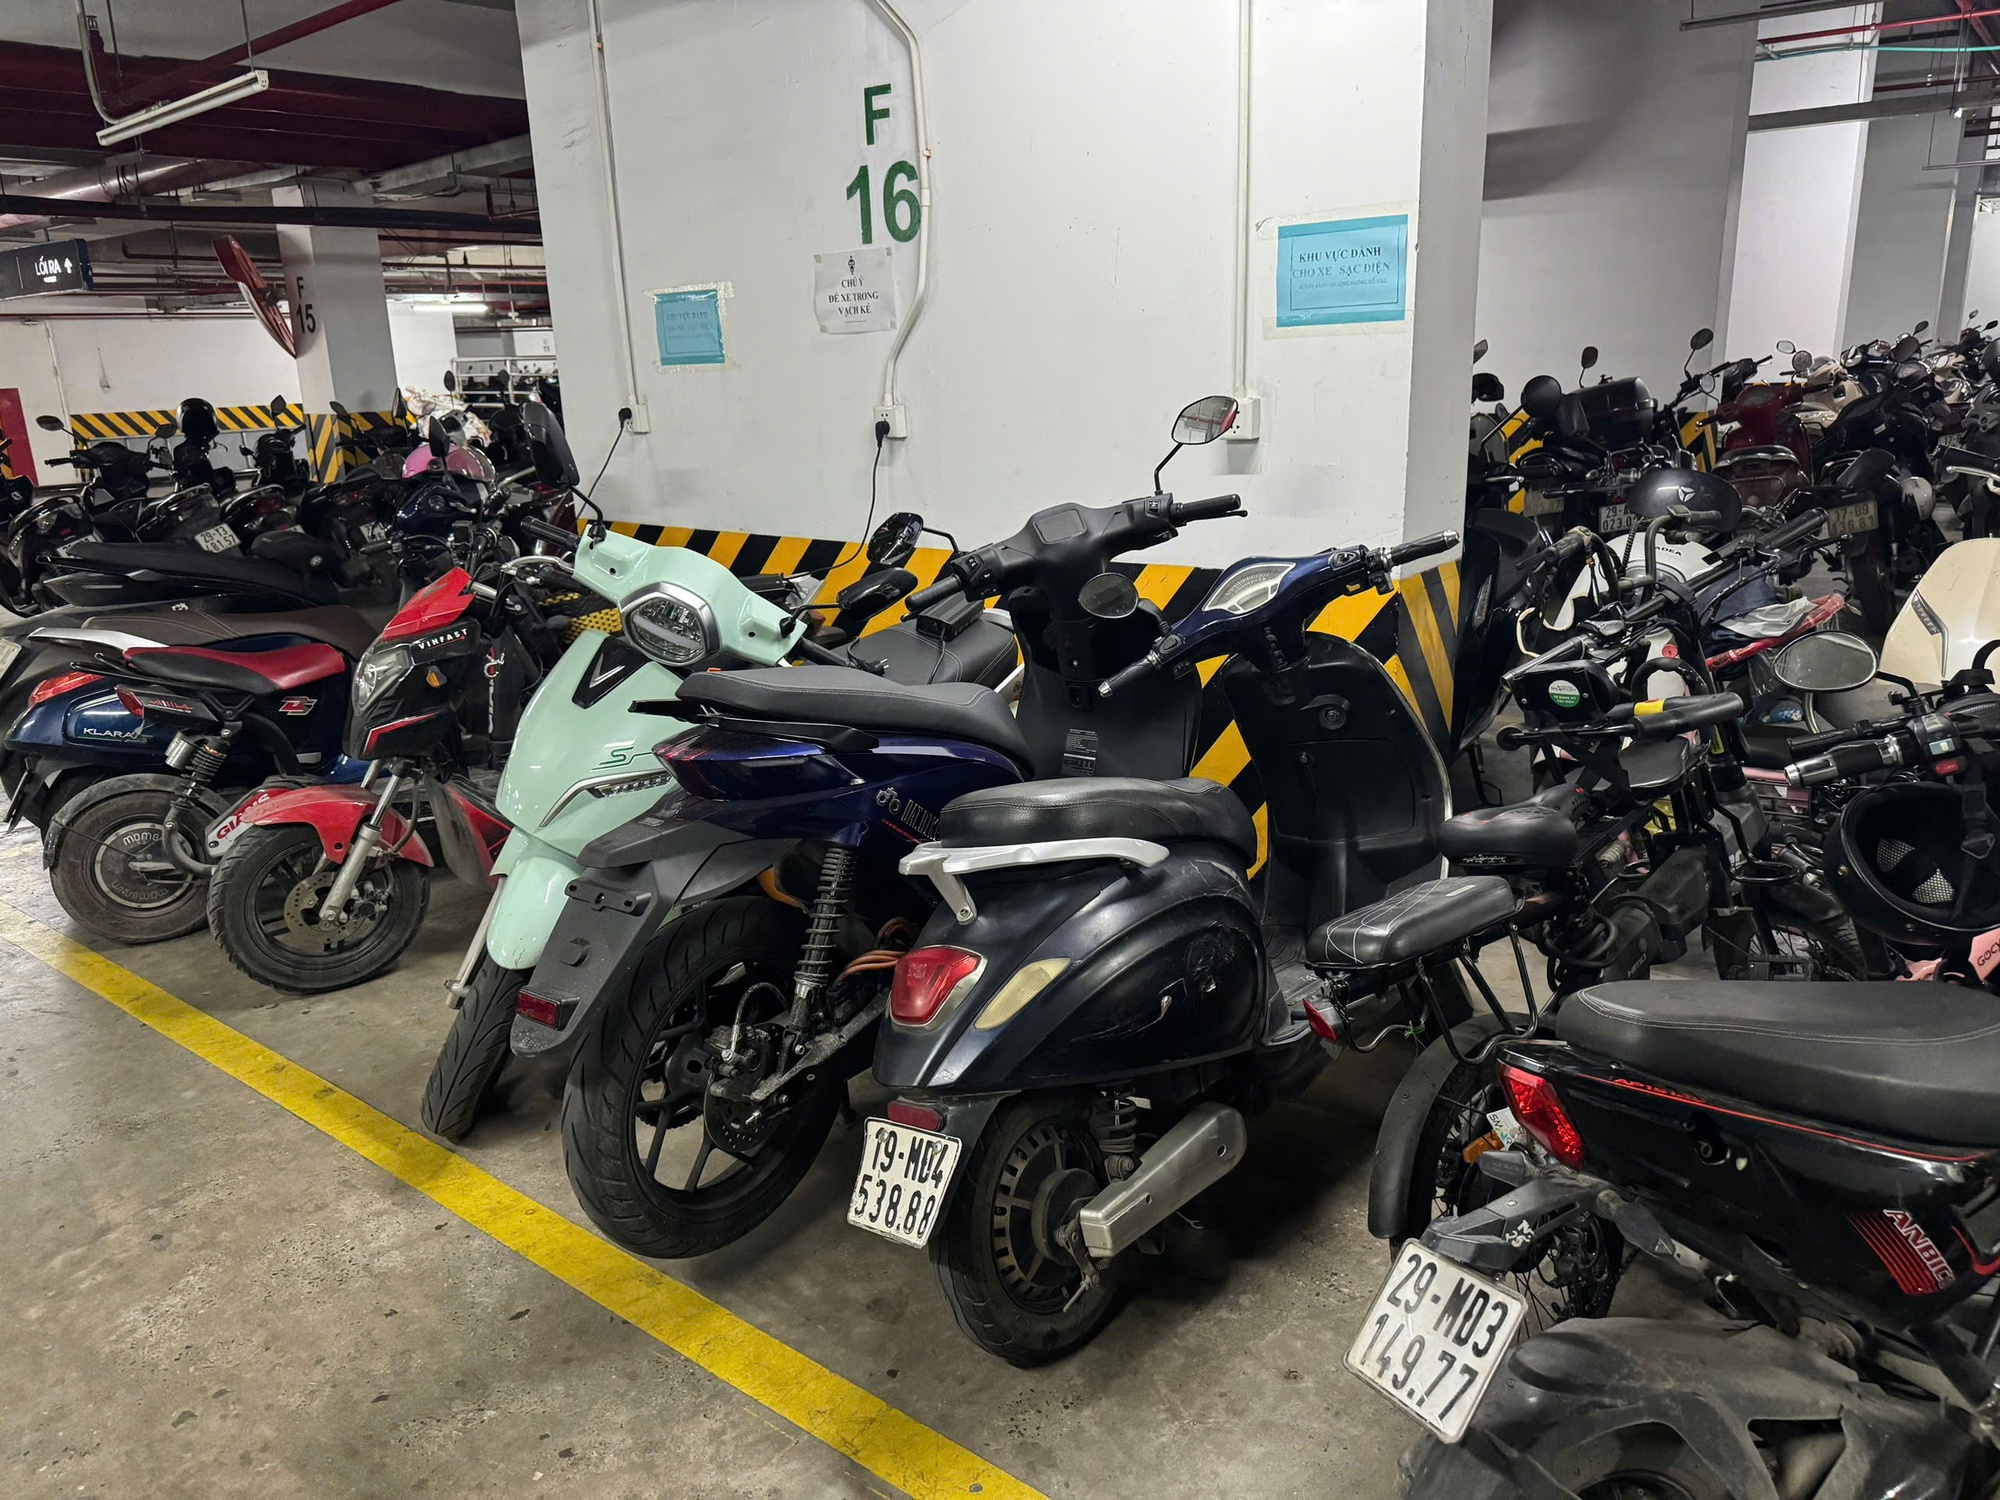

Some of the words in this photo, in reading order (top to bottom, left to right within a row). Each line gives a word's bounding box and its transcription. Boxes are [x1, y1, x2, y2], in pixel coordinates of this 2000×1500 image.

[864, 83, 891, 146] F
[846, 160, 922, 245] 16
[1299, 251, 1322, 263] KHU
[1325, 248, 1349, 262] VỰC
[1351, 246, 1381, 259] DÀNH
[1292, 267, 1315, 279] CHO
[1317, 266, 1332, 277] XE
[1339, 264, 1361, 277] SẠC
[296, 276, 304, 299] F
[840, 293, 852, 303] XE
[852, 290, 879, 302] TRONG
[296, 303, 316, 334] 15
[837, 306, 859, 317] VẠCH
[200, 525, 228, 544] 29-Y3
[418, 628, 468, 650] VINFAST
[854, 1173, 936, 1239] 538.88
[1360, 1312, 1480, 1421] 149.77
